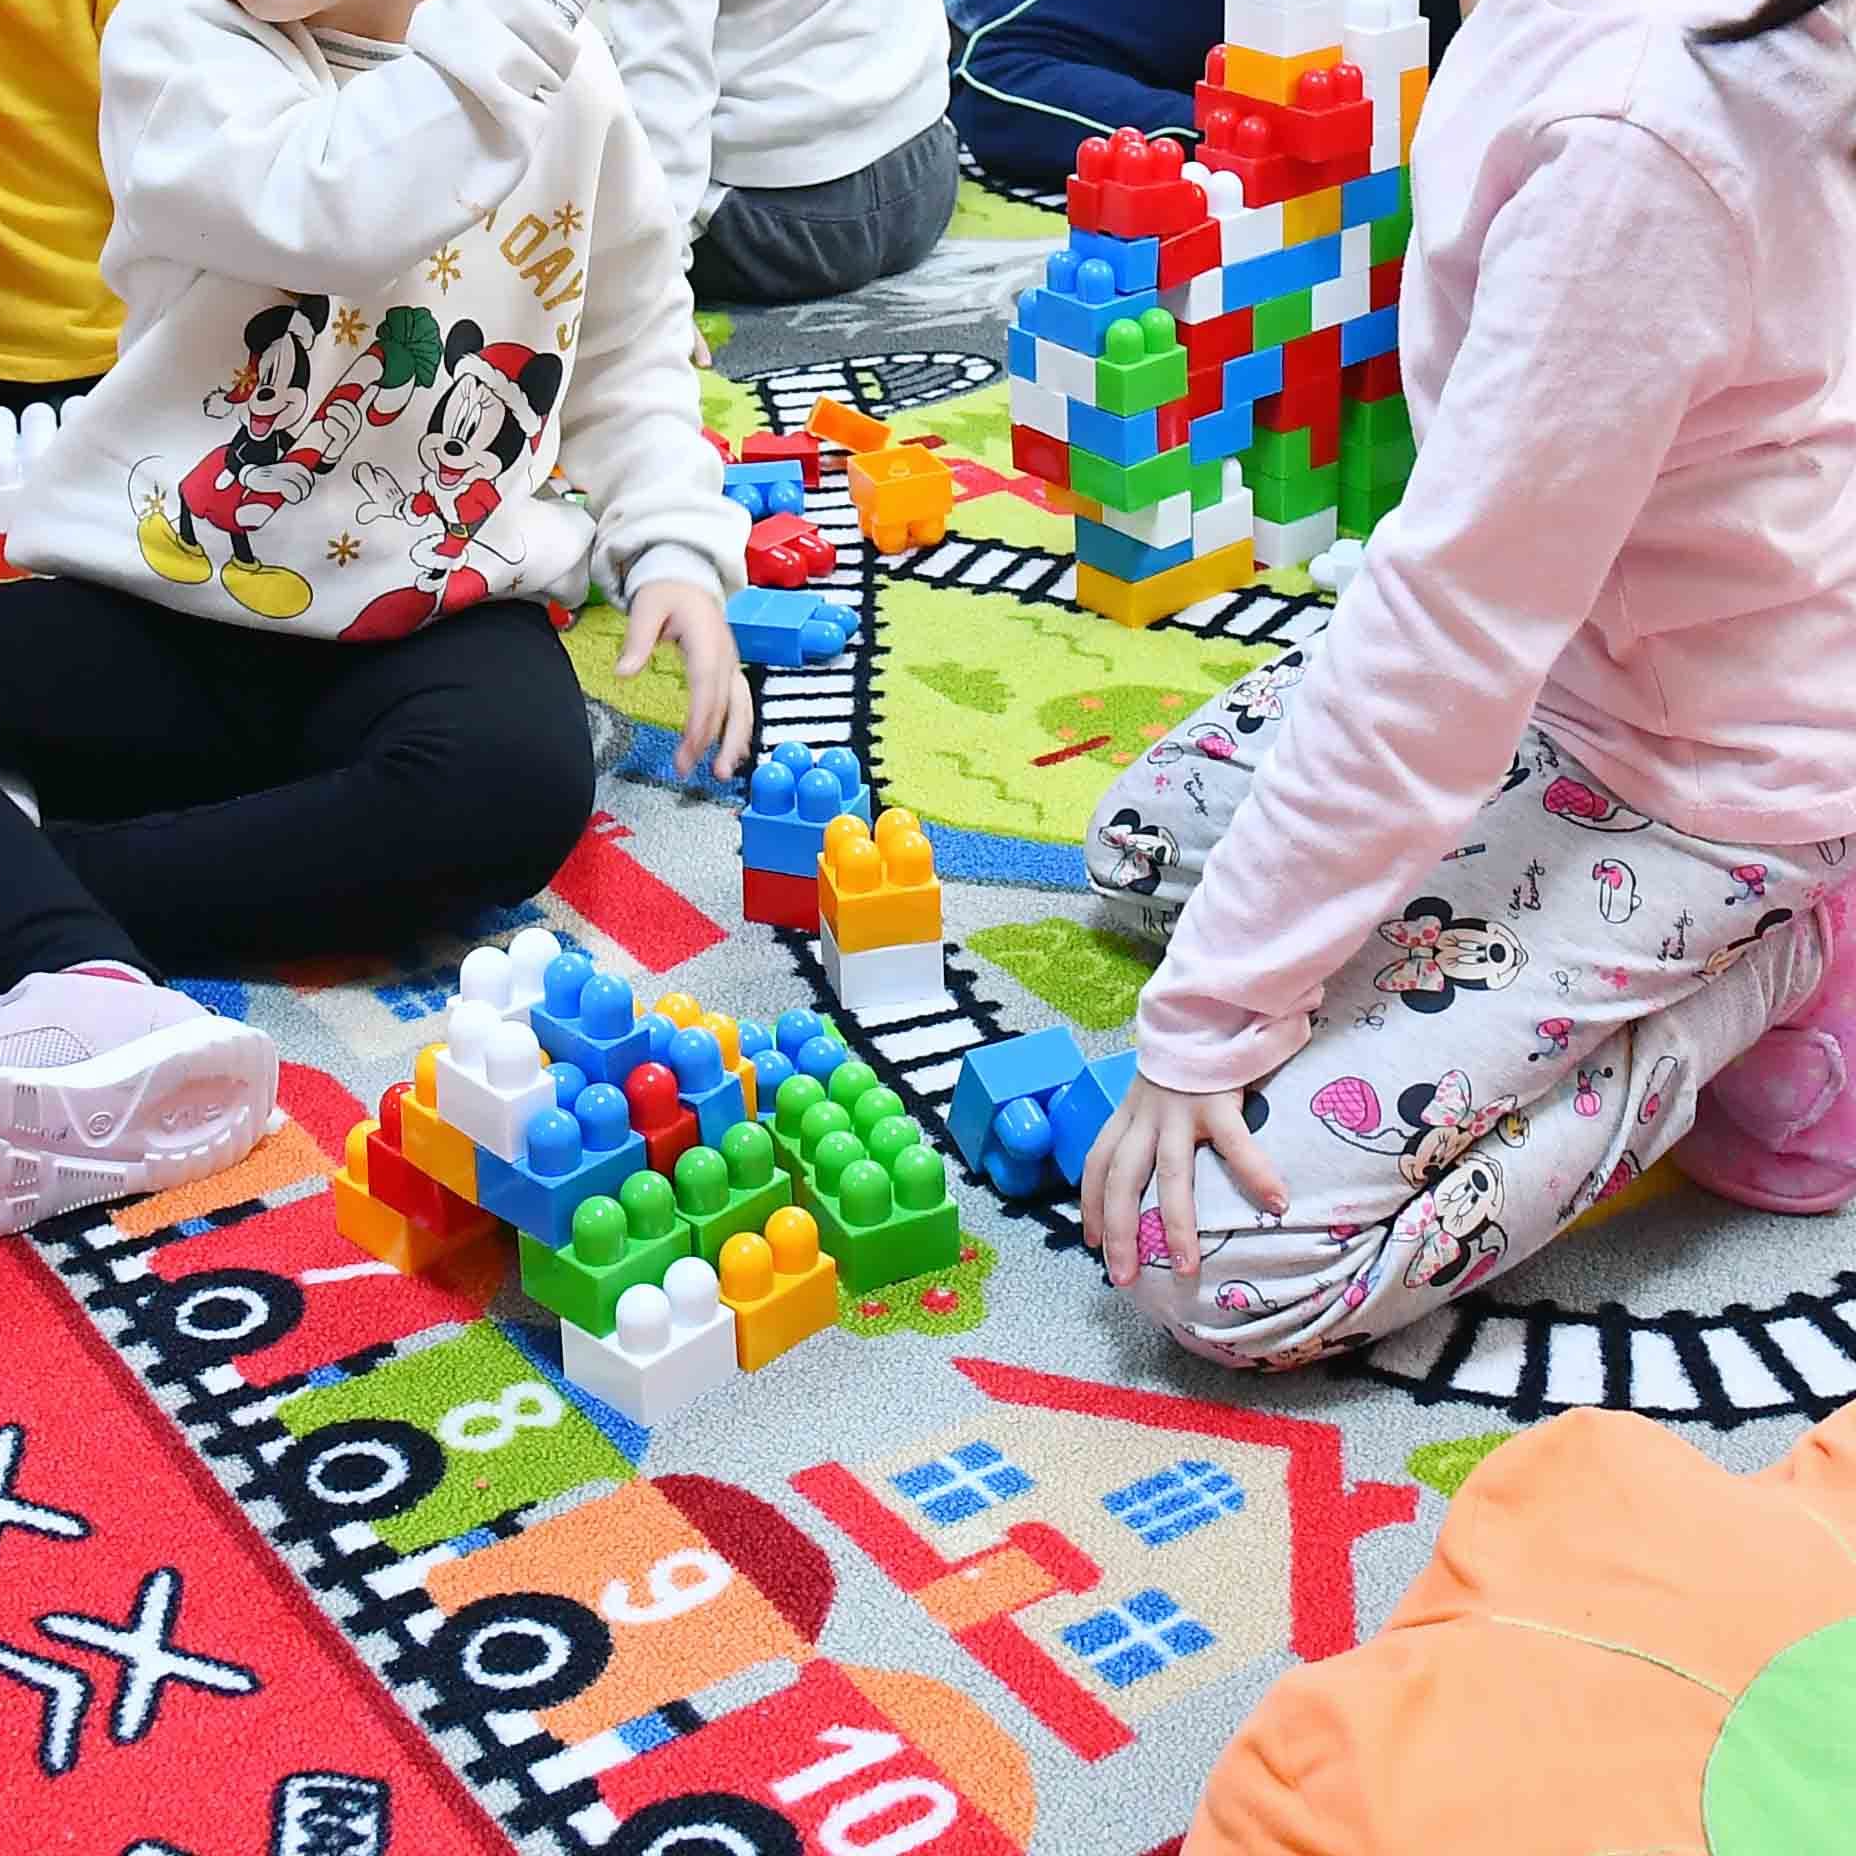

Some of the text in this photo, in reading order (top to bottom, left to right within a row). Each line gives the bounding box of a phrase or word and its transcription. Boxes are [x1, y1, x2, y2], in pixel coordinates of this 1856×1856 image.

[436, 1381, 565, 1452] 8
[600, 1547, 735, 1625] 9
[770, 1722, 959, 1856] 10
